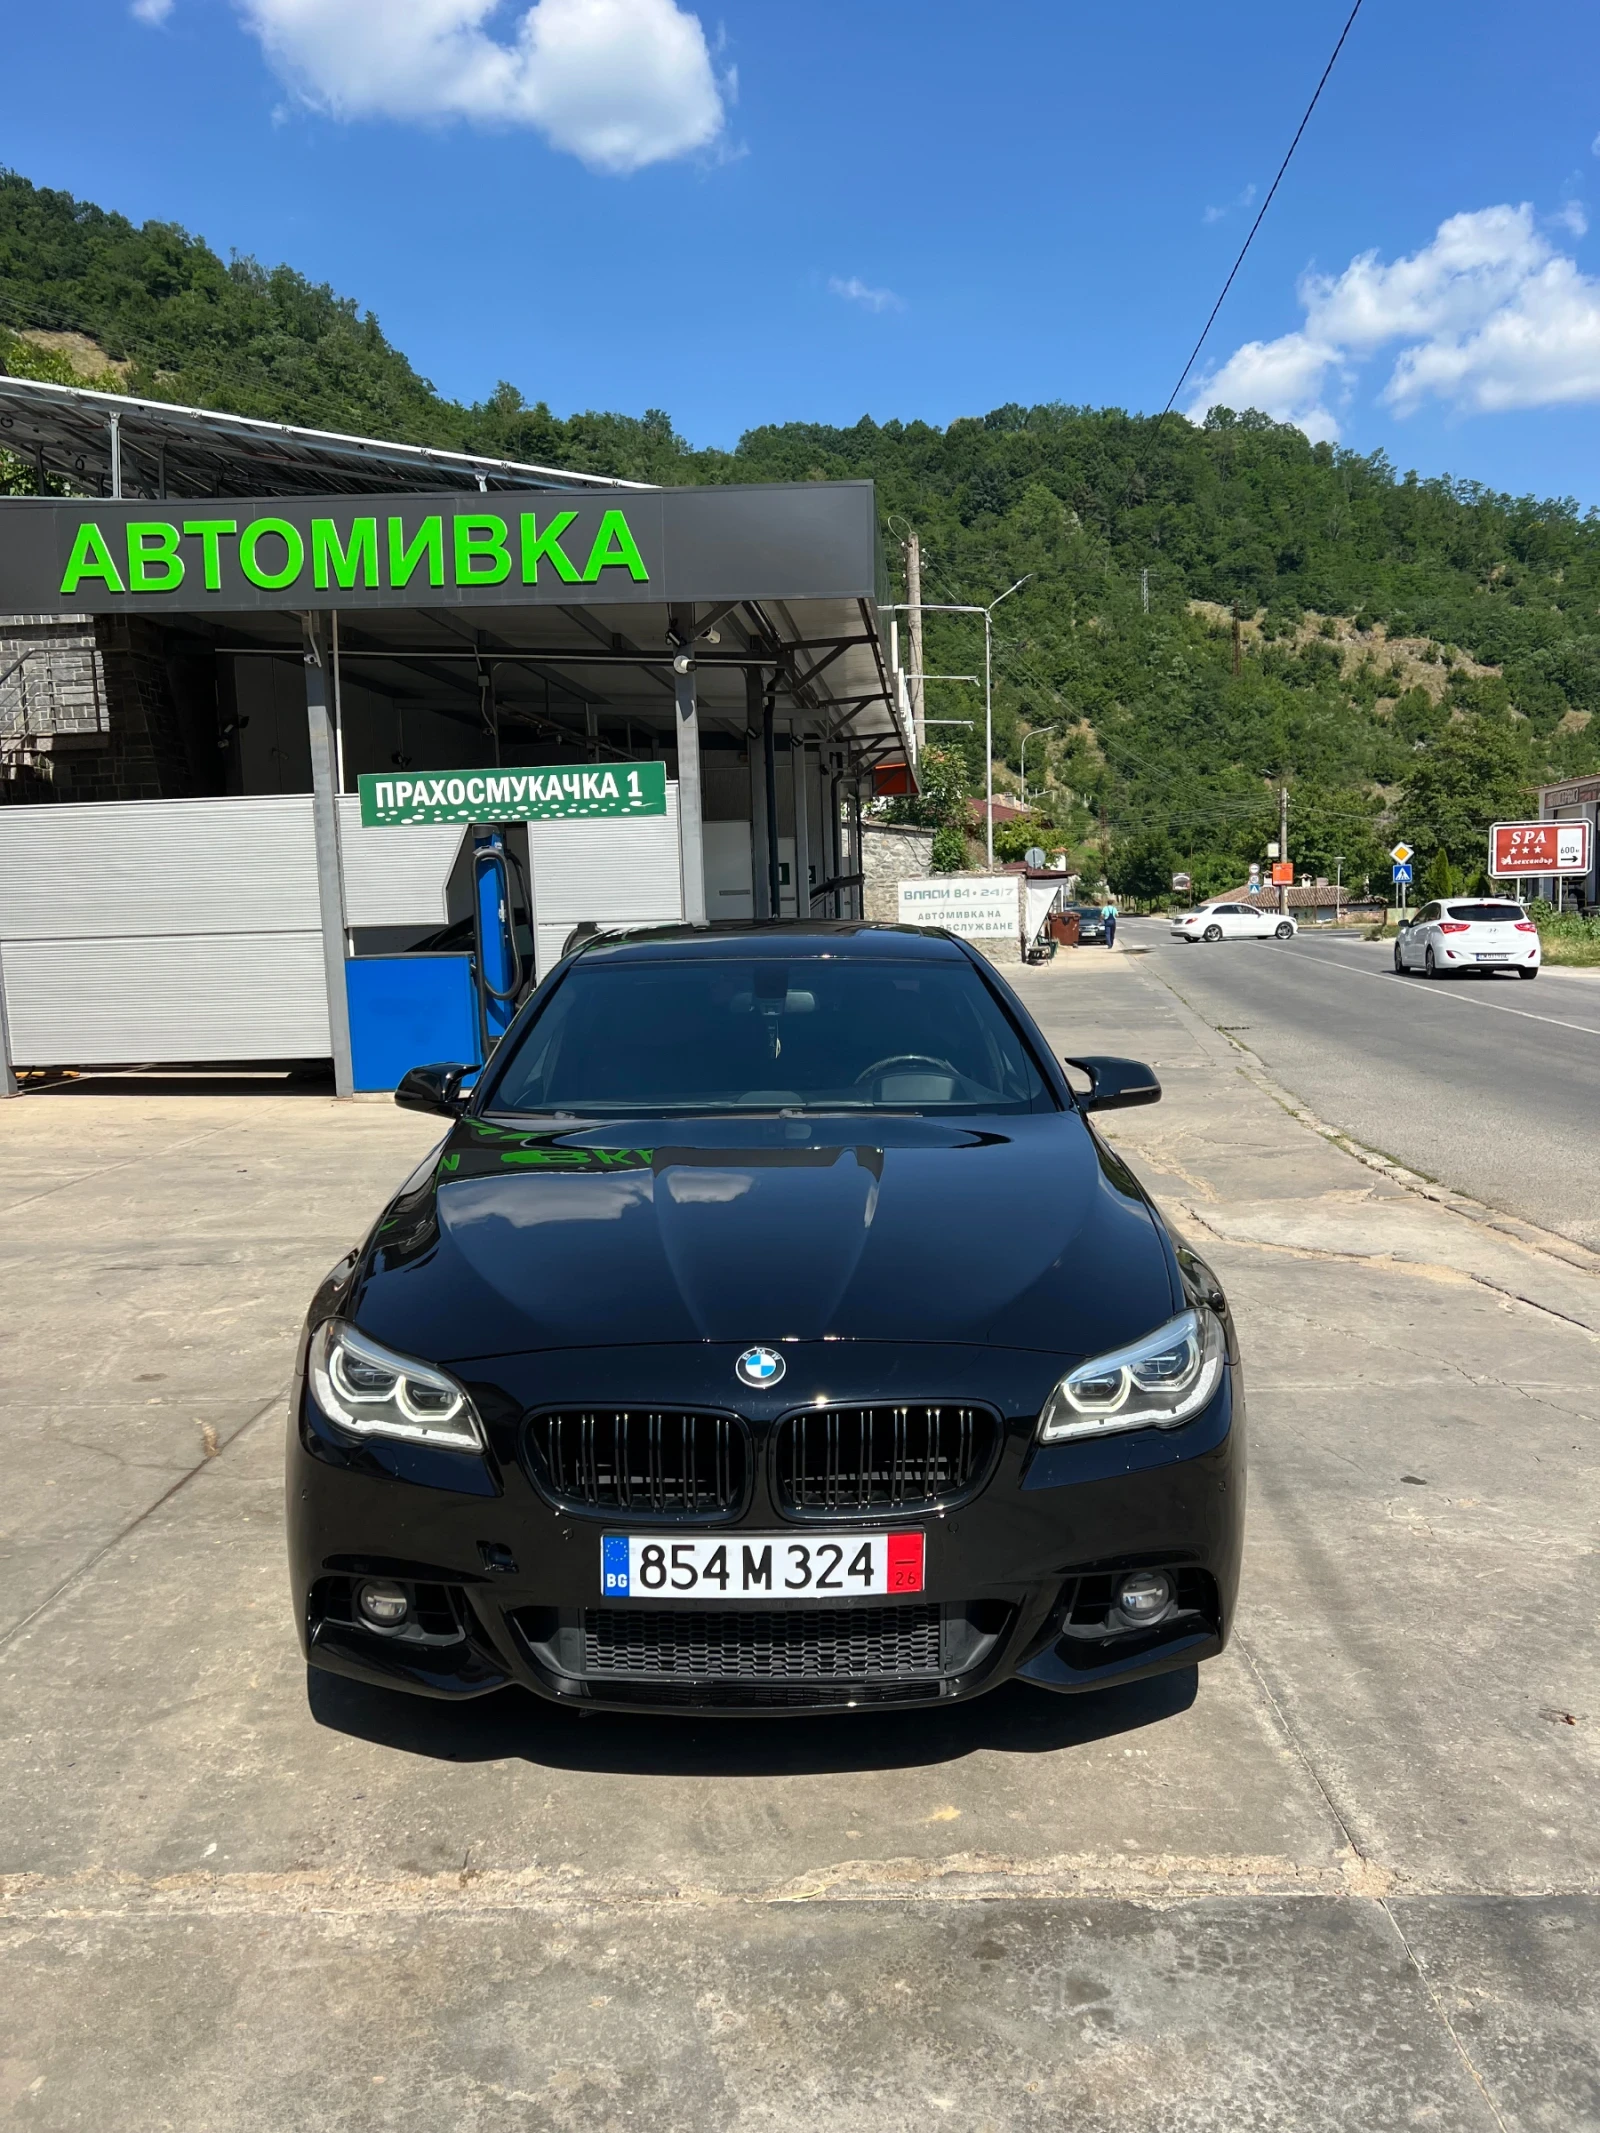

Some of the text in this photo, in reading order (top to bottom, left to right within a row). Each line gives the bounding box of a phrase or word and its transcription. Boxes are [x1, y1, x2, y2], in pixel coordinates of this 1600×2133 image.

[60, 509, 650, 593] АВТОМИВКА
[375, 770, 643, 808] ПРАХОСМУКАЧКА 1
[1511, 830, 1546, 845] SPA
[1560, 846, 1575, 854] 600
[954, 888, 969, 898] 84
[981, 888, 1014, 897] 24/7
[918, 910, 1002, 920] АВТОМИВКА НА
[741, 1348, 781, 1360] BMW
[606, 1573, 628, 1588] BG
[895, 1571, 916, 1586] 26
